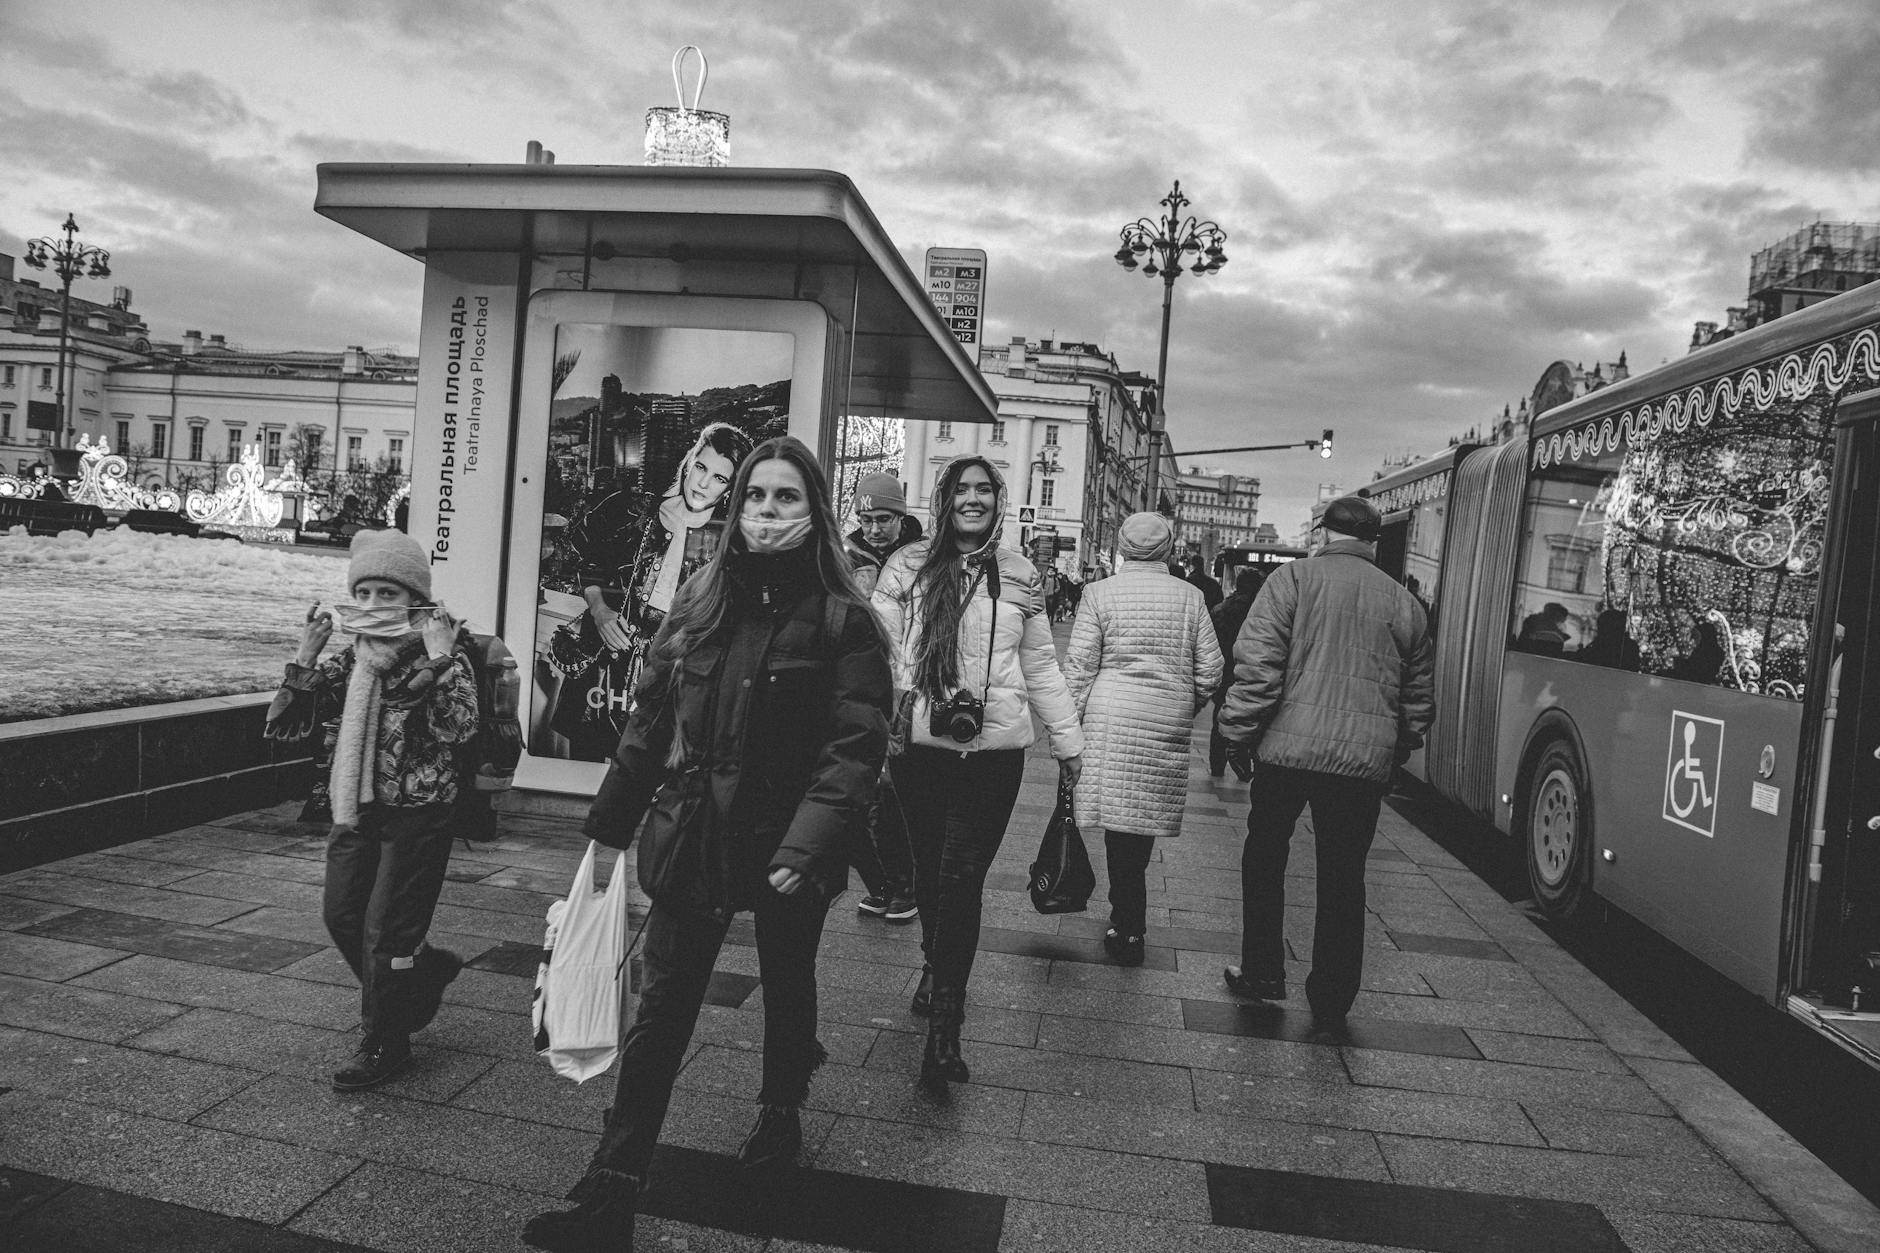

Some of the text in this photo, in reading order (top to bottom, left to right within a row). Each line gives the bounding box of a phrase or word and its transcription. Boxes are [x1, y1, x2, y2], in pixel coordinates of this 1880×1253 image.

[931, 293, 949, 302] 144
[955, 294, 977, 303] 904
[431, 296, 467, 566] Театральная площадь
[464, 296, 489, 475] Teatralnaya Ploschad
